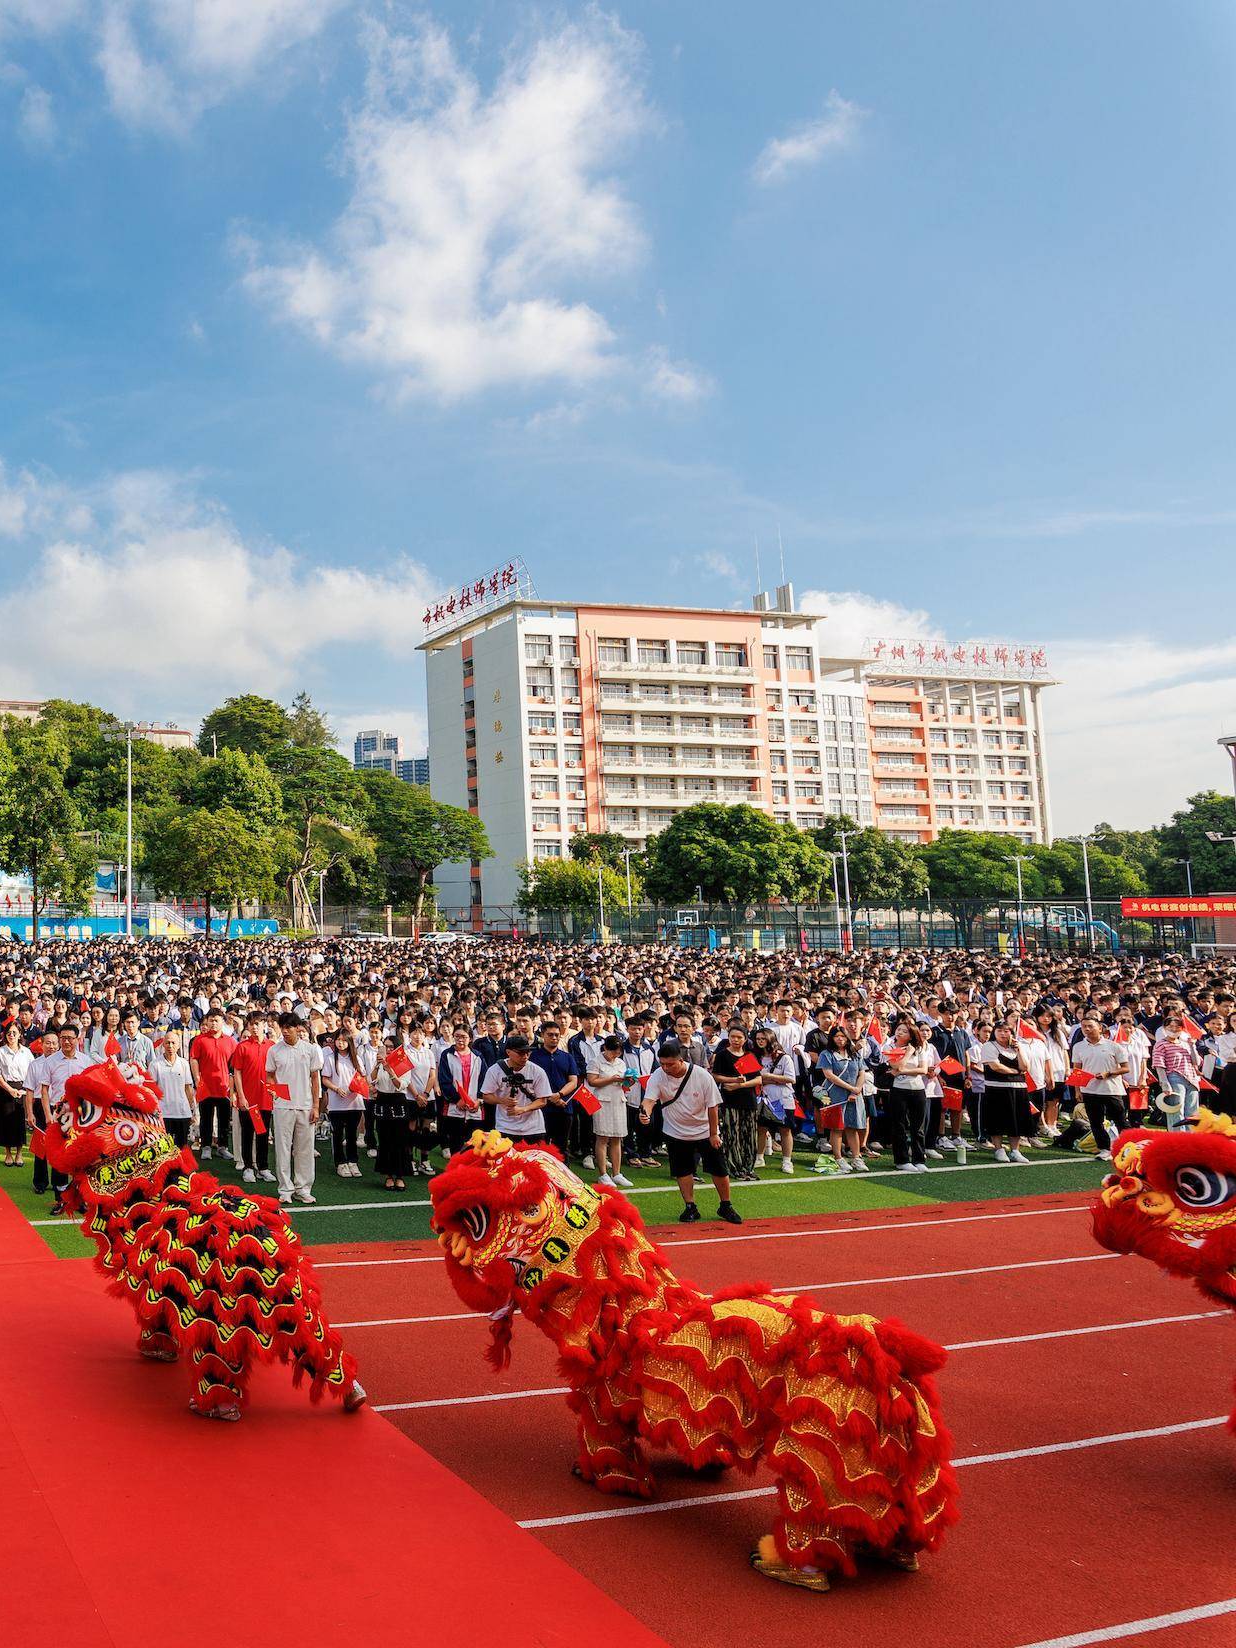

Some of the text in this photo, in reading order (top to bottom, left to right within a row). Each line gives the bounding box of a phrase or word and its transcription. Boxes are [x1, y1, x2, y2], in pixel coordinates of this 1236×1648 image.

[422, 563, 517, 631] 市机电技师学院
[873, 640, 1047, 668] 广州市机电技师学院
